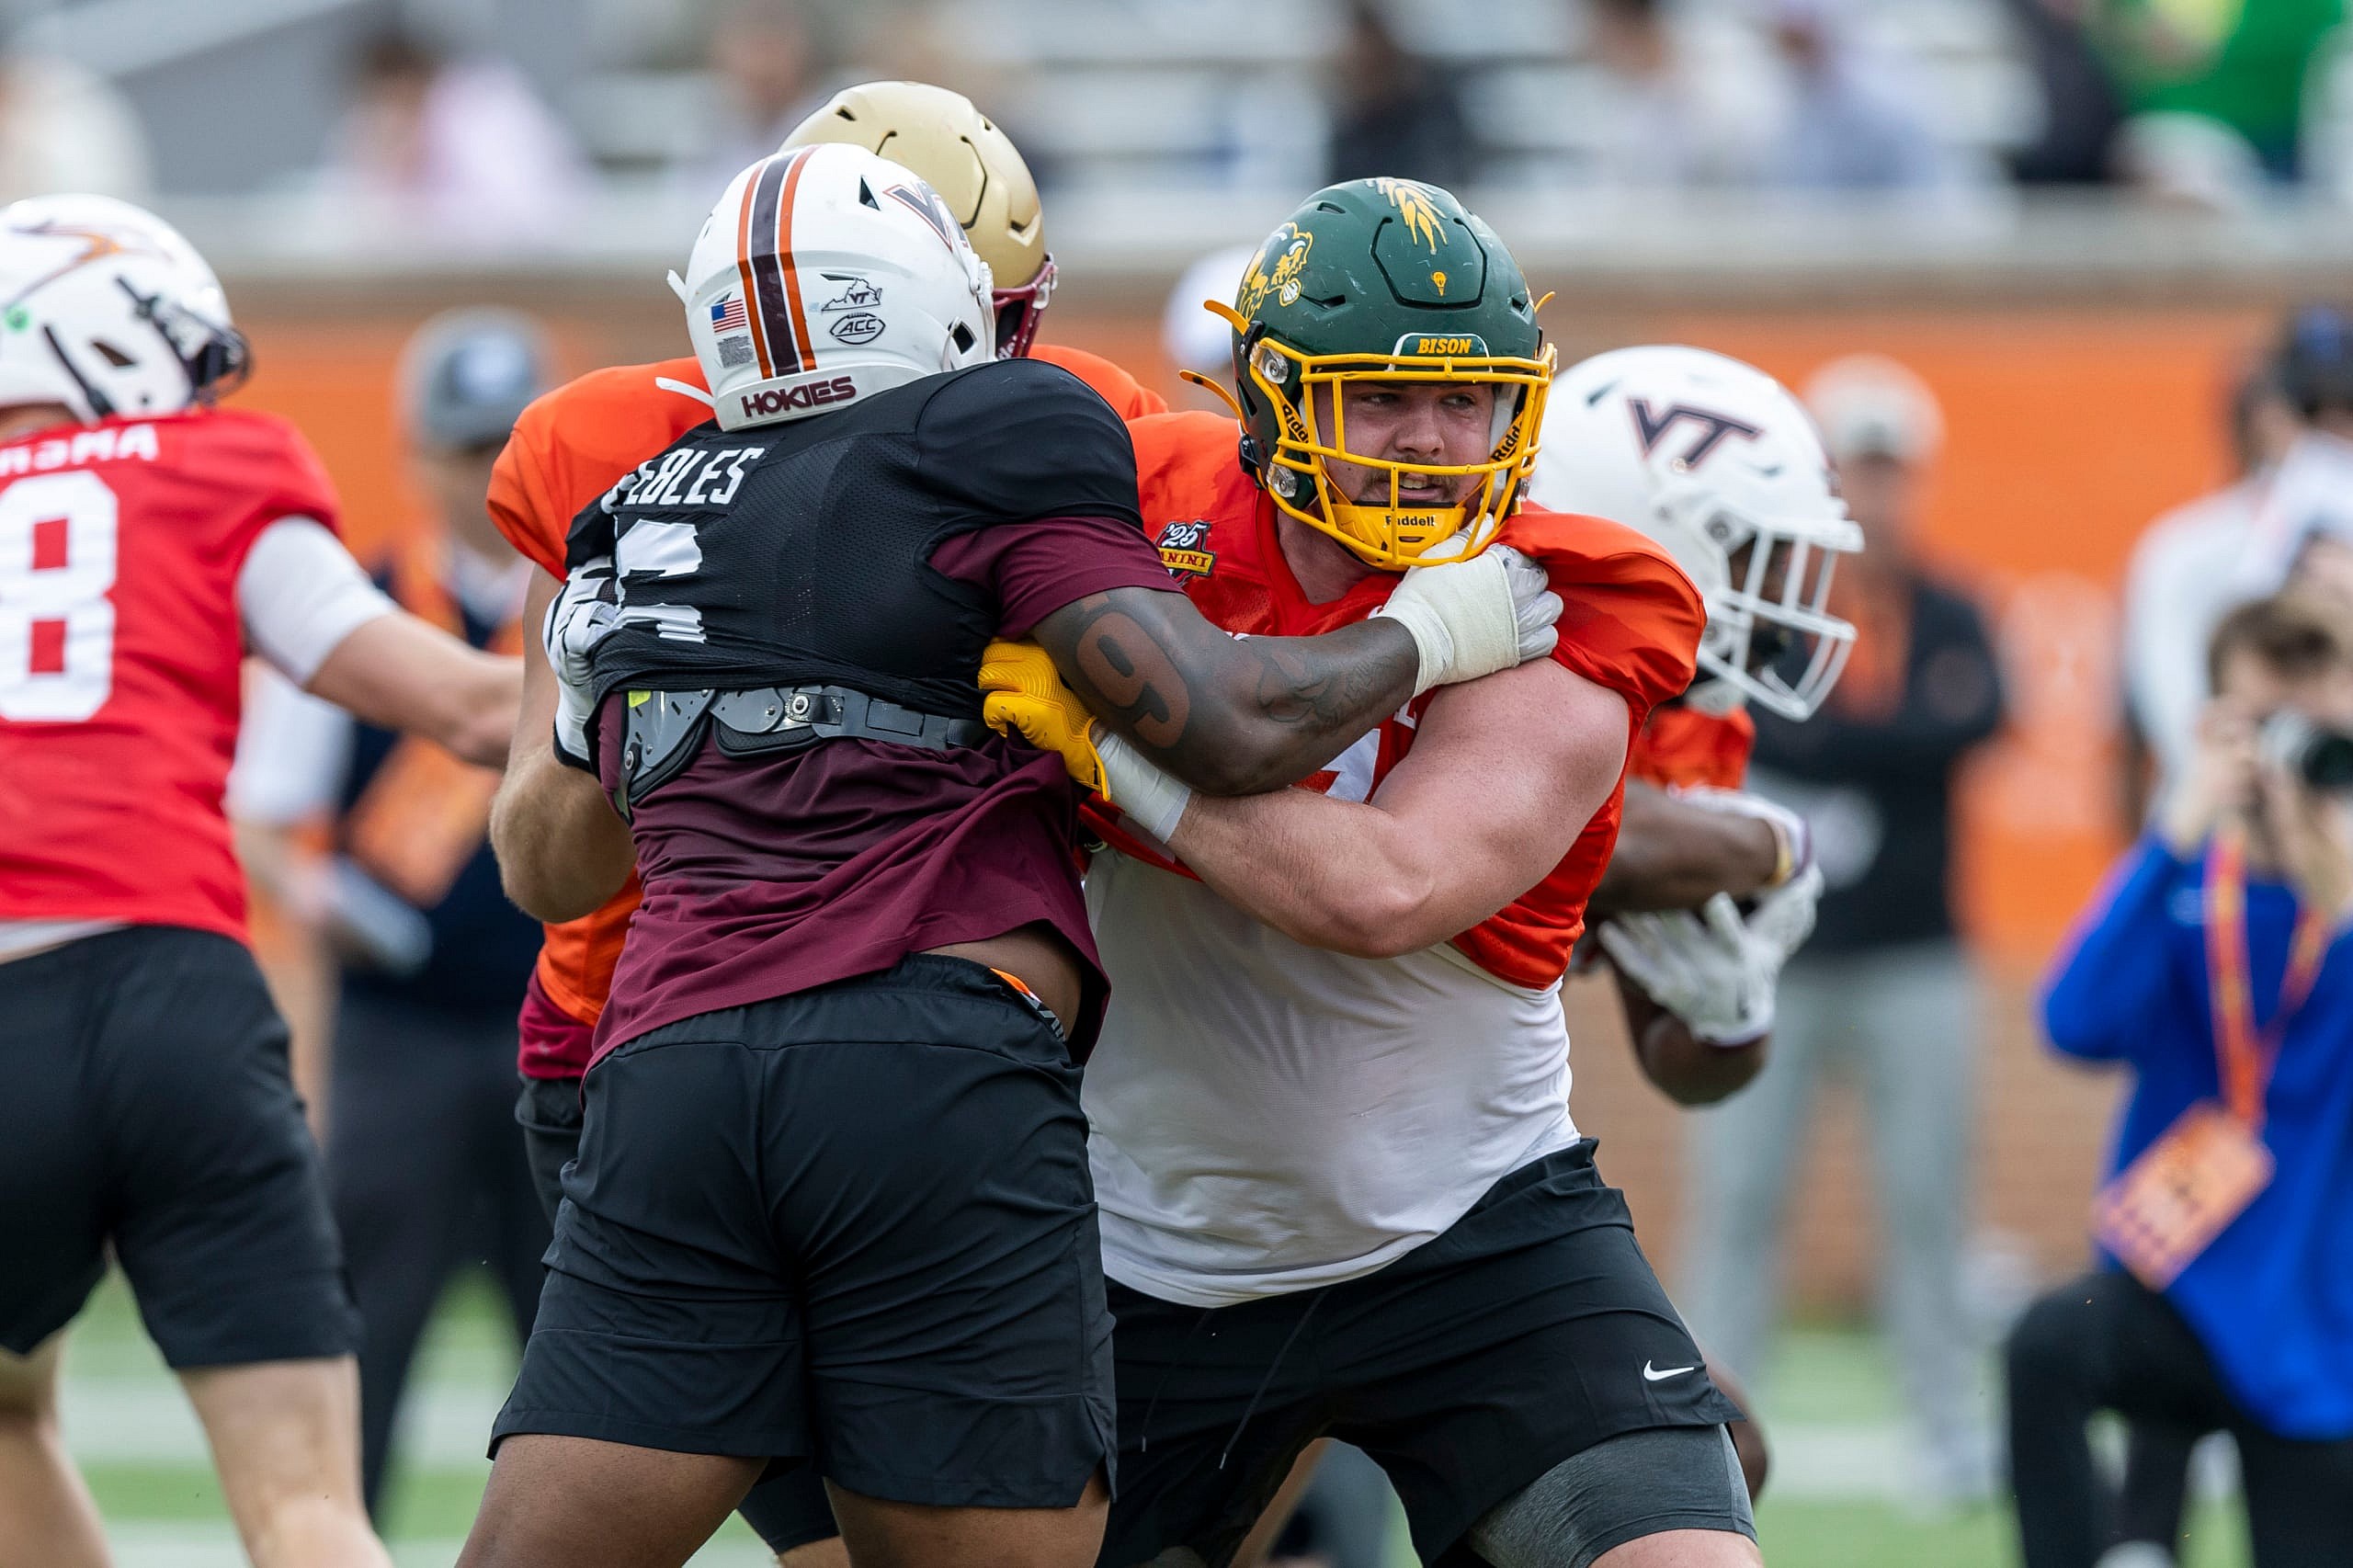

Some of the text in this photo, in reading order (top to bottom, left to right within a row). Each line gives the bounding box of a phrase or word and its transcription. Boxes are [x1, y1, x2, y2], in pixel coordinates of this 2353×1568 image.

[849, 291, 870, 304] VT
[839, 318, 878, 335] ACC
[1416, 337, 1472, 354] BISON
[741, 376, 857, 417] HOKIES
[1282, 404, 1309, 444] Ridd
[1491, 421, 1523, 461] Ridd
[1628, 397, 1760, 471] VT
[1161, 551, 1209, 567] NINI
[0, 470, 119, 722] 8
[1076, 610, 1190, 749] 9
